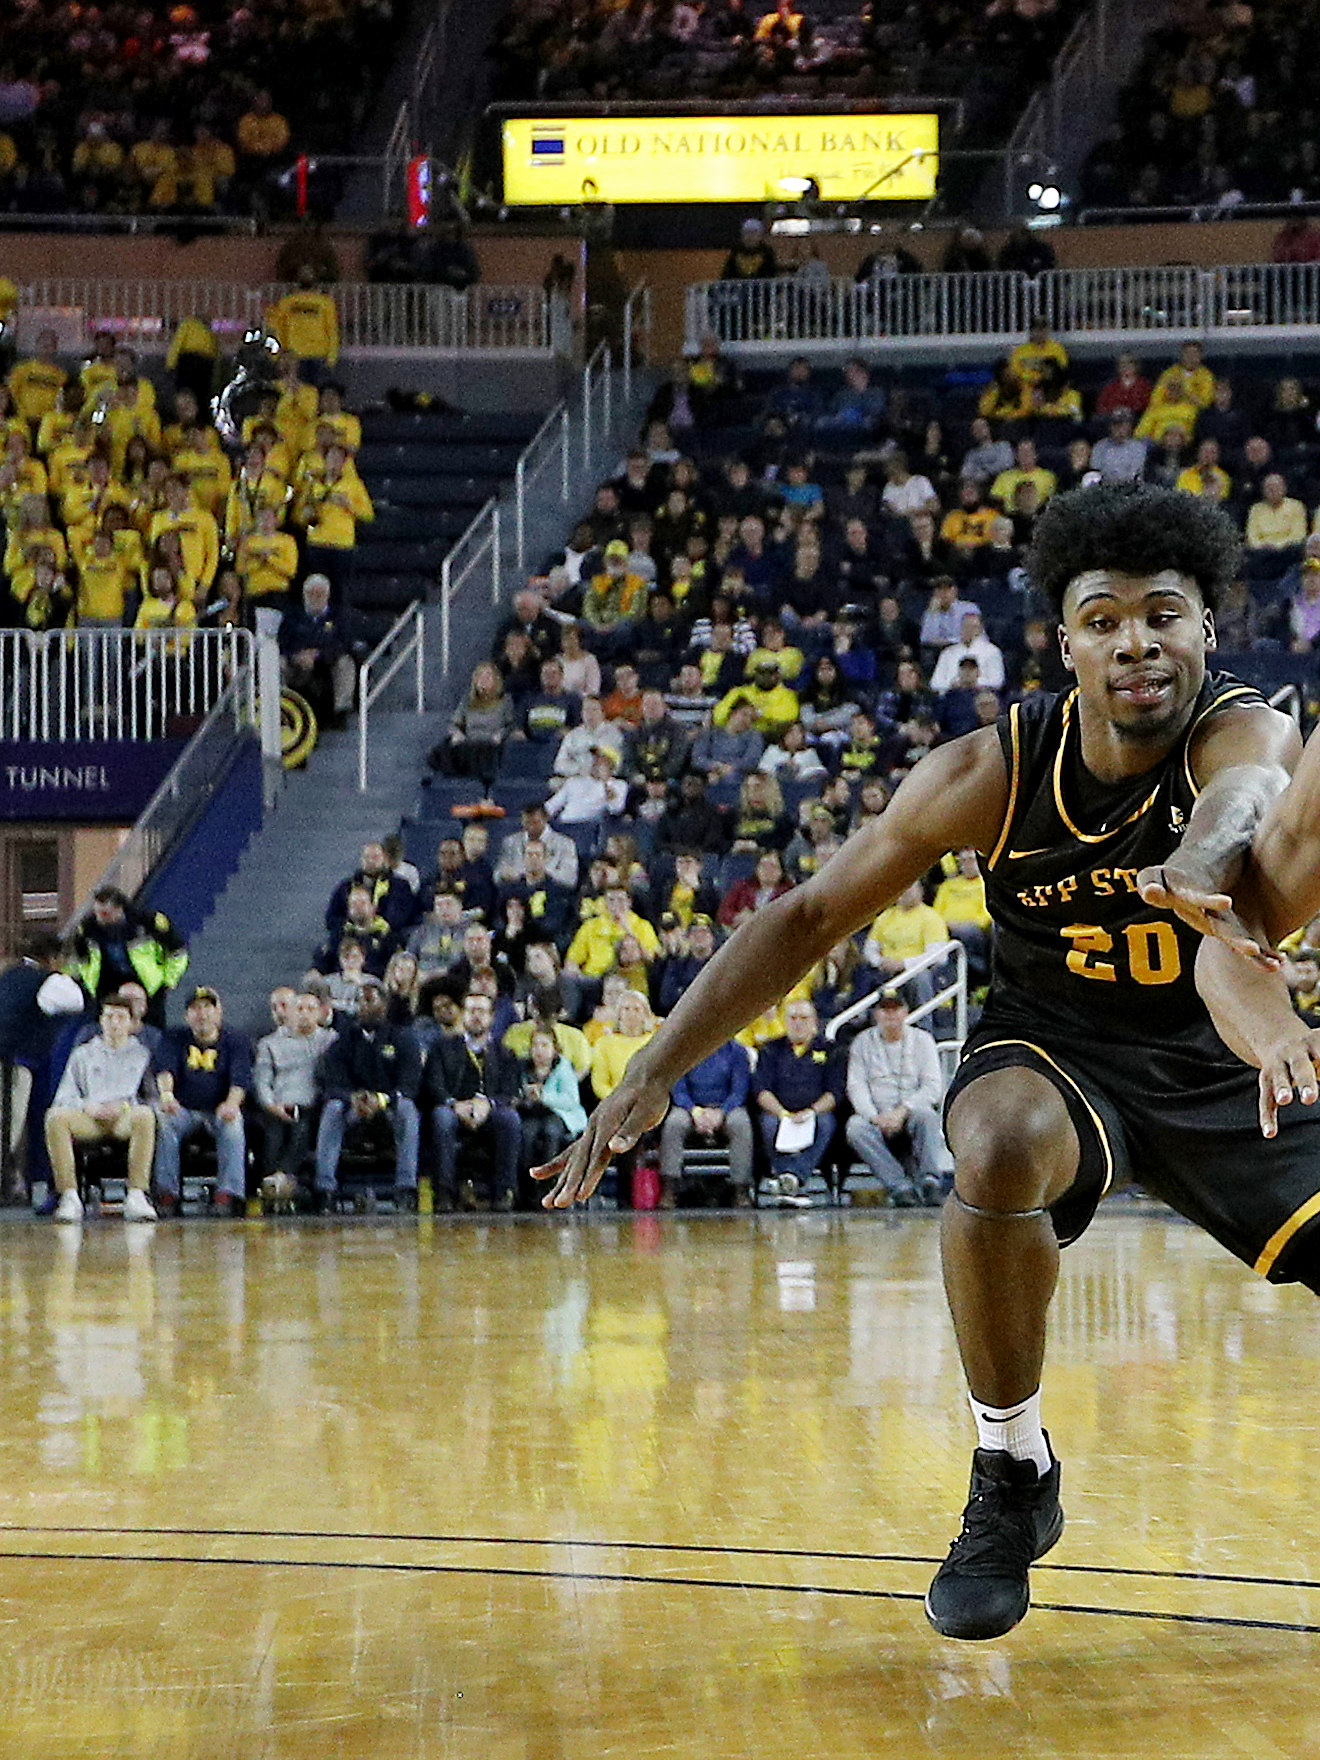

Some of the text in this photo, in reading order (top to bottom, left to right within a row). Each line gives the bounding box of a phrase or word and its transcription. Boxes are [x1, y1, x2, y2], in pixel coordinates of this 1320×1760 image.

[577, 131, 907, 155] OLD NATIONAL BANK
[5, 765, 110, 791] TUNNEL
[1060, 922, 1182, 985] 20
[186, 1044, 218, 1071] M
